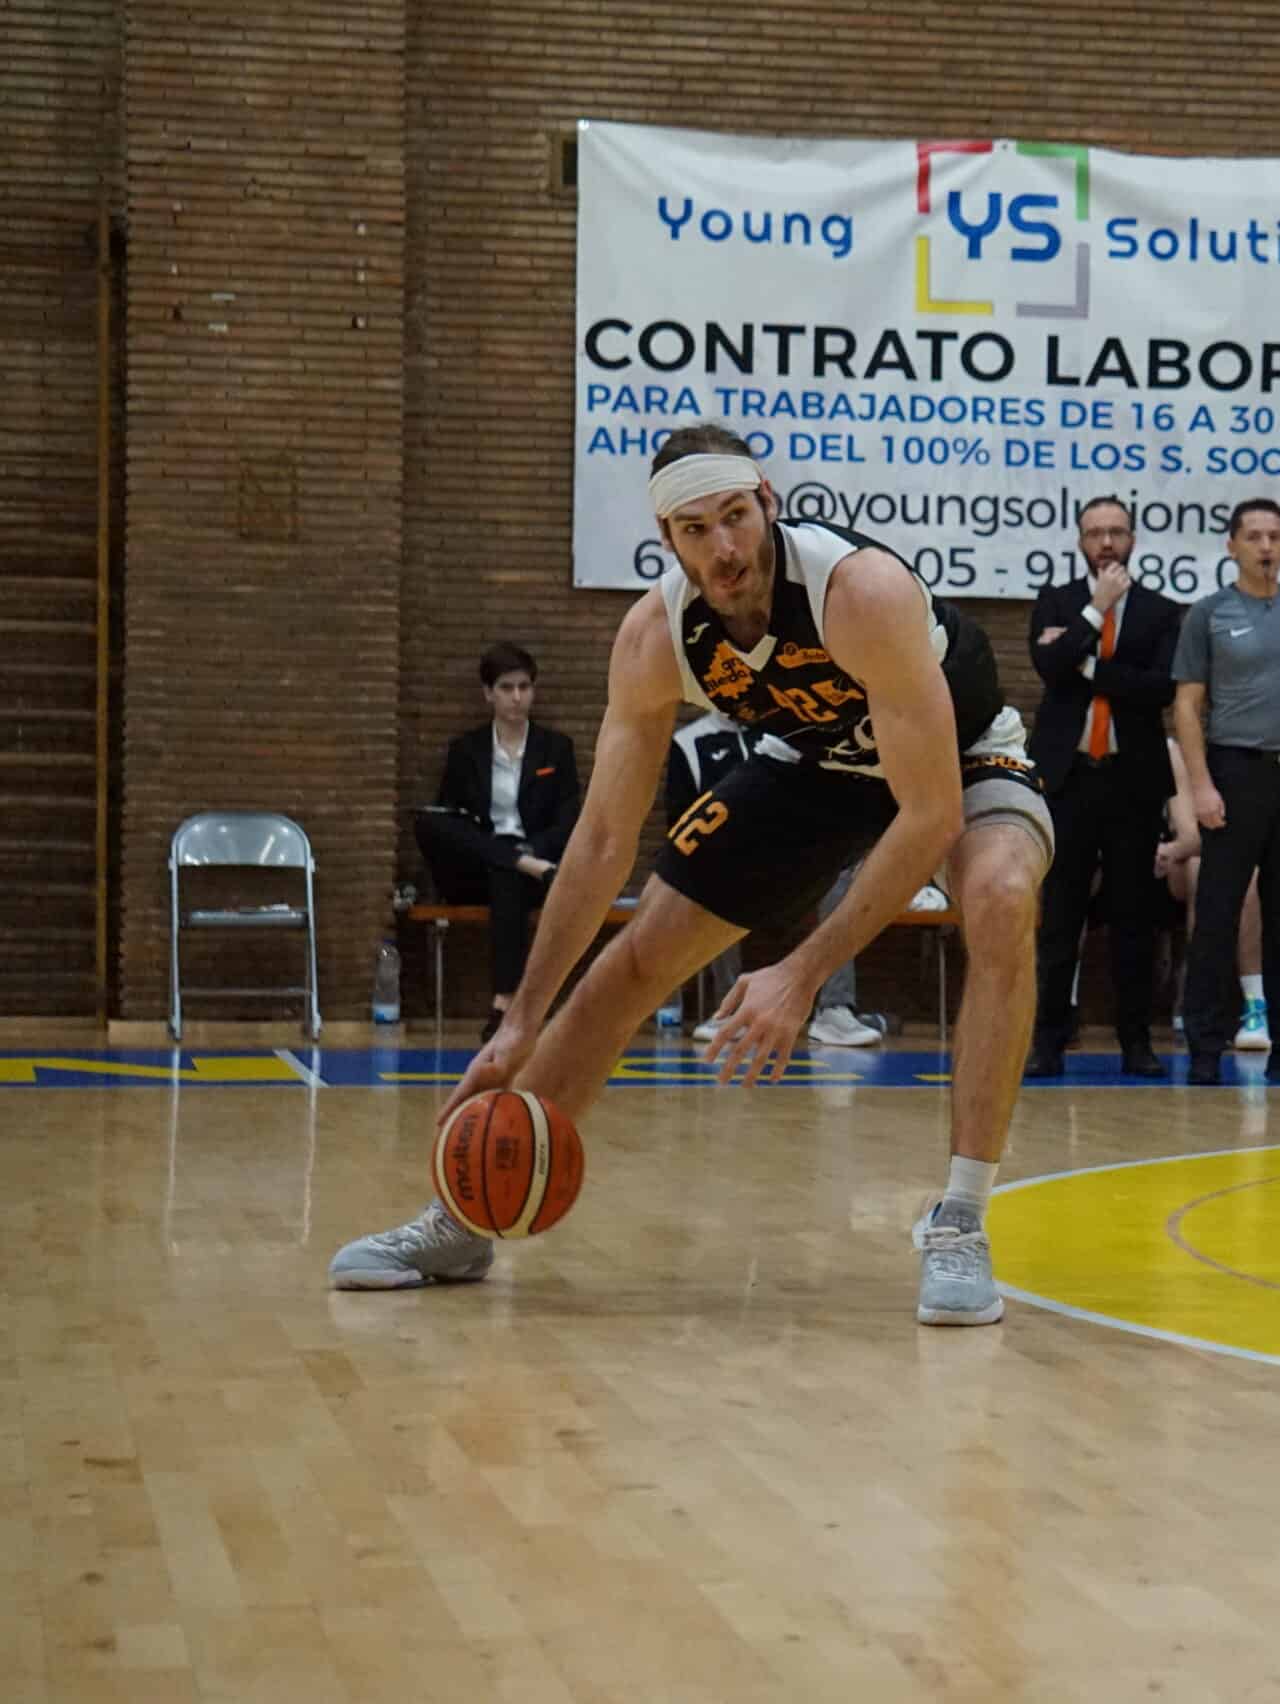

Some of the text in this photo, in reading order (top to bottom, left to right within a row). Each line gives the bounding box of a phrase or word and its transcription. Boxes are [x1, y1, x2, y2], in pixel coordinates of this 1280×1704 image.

[658, 197, 853, 259] Young
[947, 191, 1062, 262] YS
[584, 318, 1015, 382] CONTRATO
[586, 384, 701, 416] PARA
[714, 387, 1045, 427] TRABAJADORES
[1060, 401, 1114, 430] DE
[1131, 402, 1175, 432] 16
[1189, 406, 1216, 433] A
[1230, 406, 1274, 434] 30
[789, 434, 865, 463] DEL
[881, 435, 991, 465] 100%
[1004, 439, 1055, 468] DE
[1070, 442, 1146, 472] LOS
[1160, 444, 1192, 474] S.
[1137, 553, 1199, 594] 86
[667, 789, 730, 857] 12
